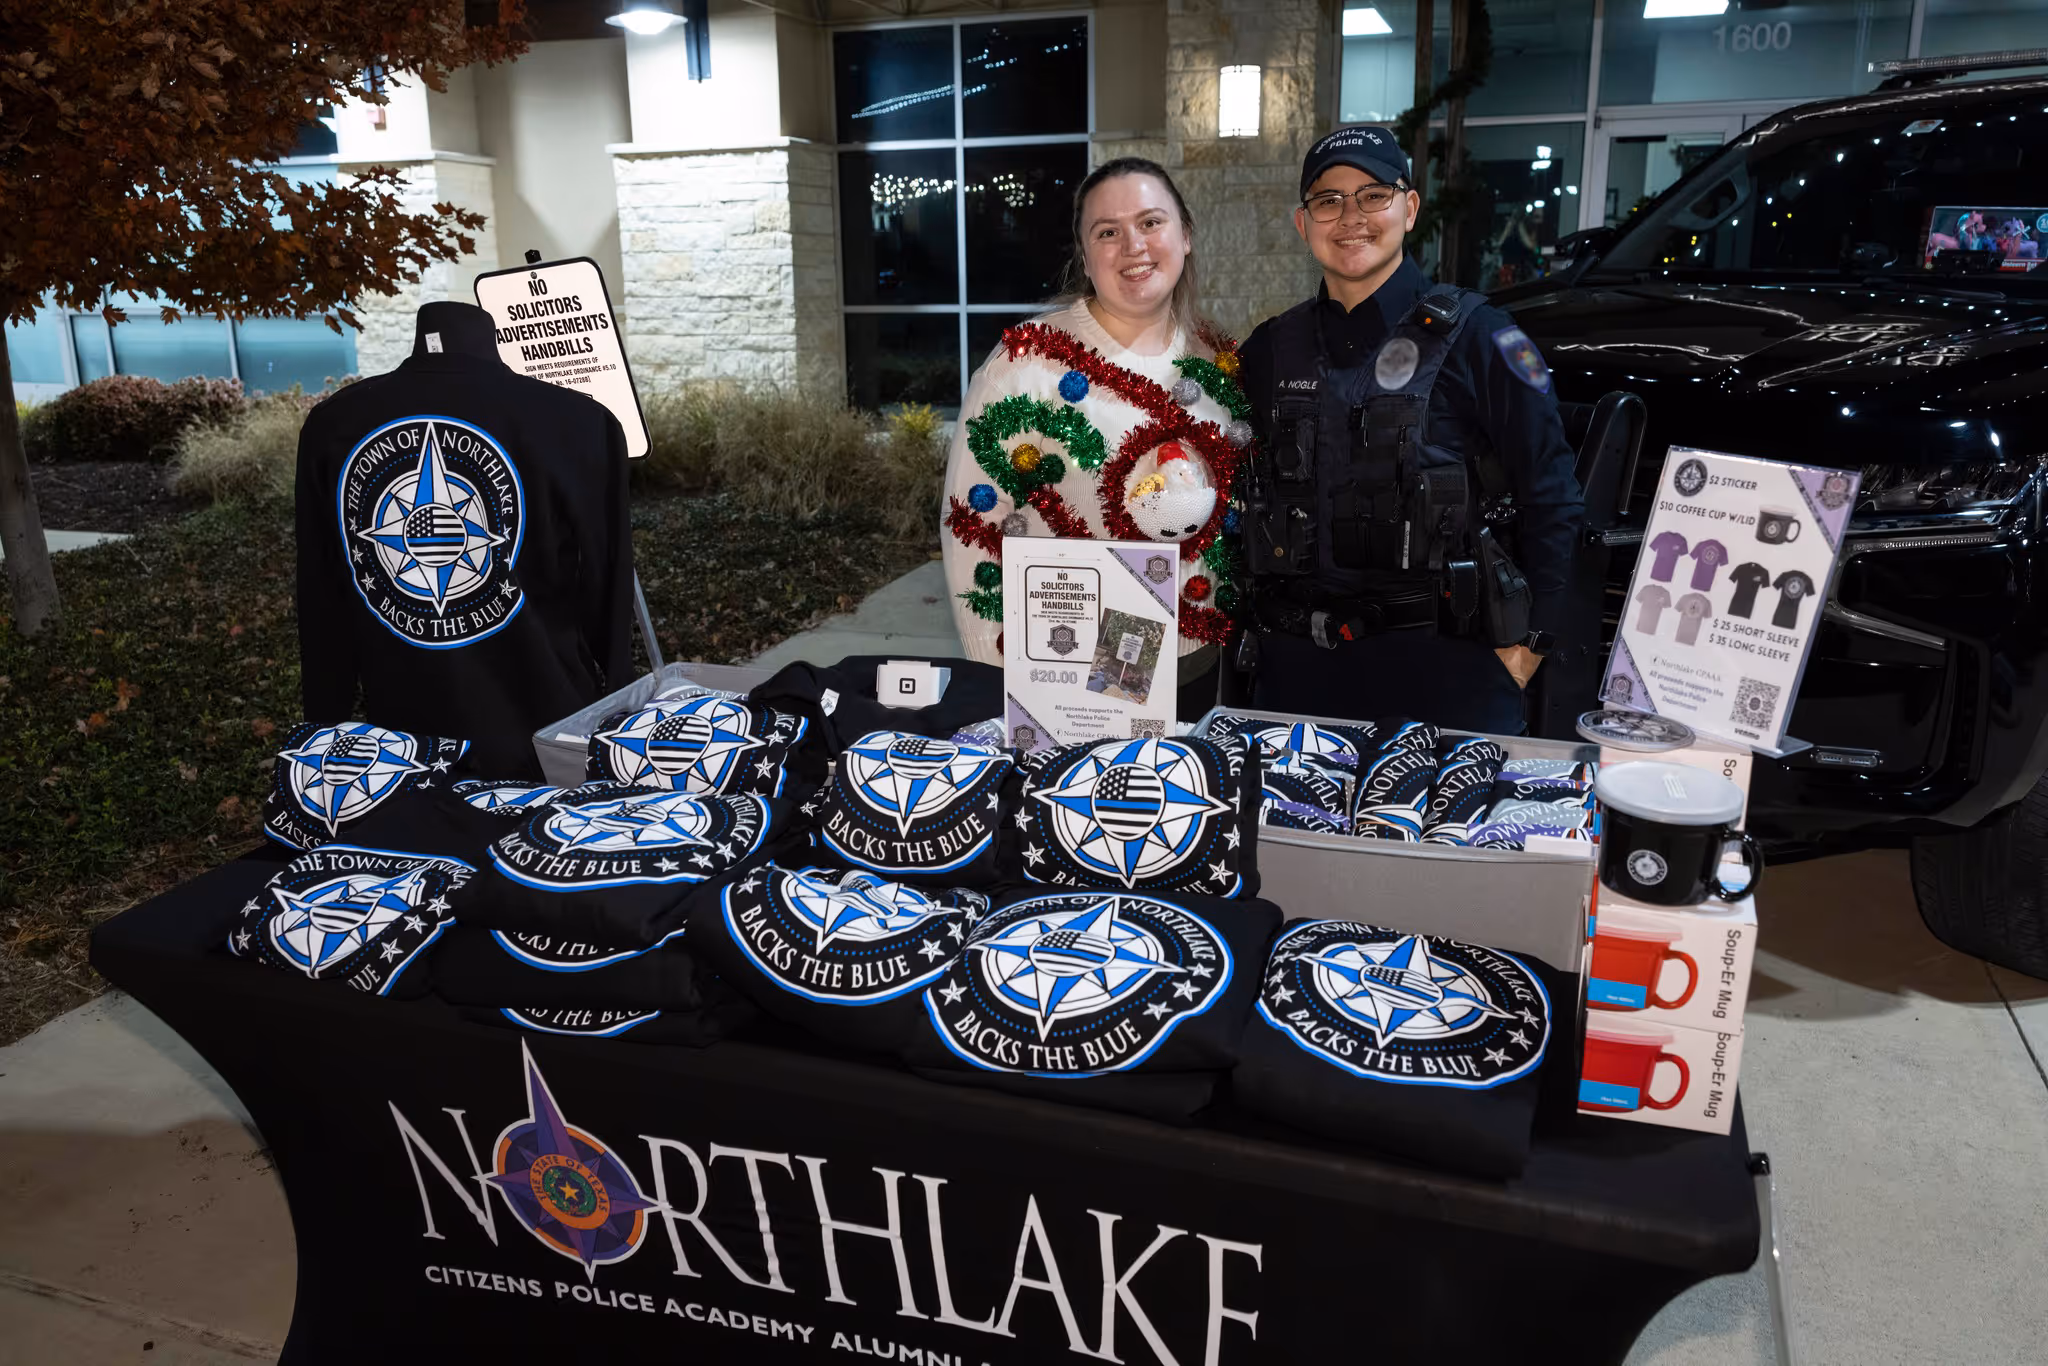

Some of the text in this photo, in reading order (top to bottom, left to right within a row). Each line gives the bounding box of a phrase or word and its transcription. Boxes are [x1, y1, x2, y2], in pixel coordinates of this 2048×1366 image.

[1712, 21, 1792, 52] 1600
[1329, 138, 1364, 150] POLICE
[528, 278, 548, 297] NO
[507, 295, 582, 321] SOLICITORS
[495, 313, 609, 345] ADVERTISEMENTS
[521, 337, 594, 362] HANDBILLS
[537, 363, 554, 371] MEETS
[554, 358, 592, 369] REQUIREMENTS
[545, 369, 573, 378] NORTHLAKE
[574, 365, 602, 375] ORDINANCE
[1288, 380, 1319, 390] NOGLE
[349, 428, 514, 516] THE TOWN OF NORTHLAKE
[1709, 475, 1759, 491] $2 STICKER
[1660, 501, 1757, 526] $10 COFFEE CUP W/LID
[1041, 581, 1085, 592] SOLICITORS
[1057, 572, 1068, 581] NO
[1029, 590, 1097, 602] ADVERTISEMENTS
[1041, 600, 1084, 611] HANDBILLS
[379, 596, 506, 637] BACKS THE BLUE
[1720, 620, 1731, 631] 25
[1733, 624, 1765, 639] SHORT
[1766, 632, 1800, 648] SLEEVE
[1716, 635, 1727, 646] 35
[1728, 639, 1756, 654] LONG
[1757, 646, 1791, 662] SLEEVE
[1029, 668, 1078, 684] $20.00
[1062, 706, 1088, 714] proceeds
[1094, 714, 1111, 722] Police
[1063, 730, 1096, 738] Northlake
[827, 809, 986, 863] BACKS THE BLUE
[288, 853, 324, 874] THE
[327, 853, 392, 870] TOWN
[499, 832, 643, 878] BACKS THE BLUE
[1070, 896, 1100, 905] OF
[1123, 900, 1216, 961] NORTHLAKE
[1280, 935, 1318, 952] THE
[1310, 922, 1374, 940] TOWN
[740, 904, 911, 989] BACKS THE BLUE
[1720, 929, 1742, 986] Soup-Er
[1712, 989, 1733, 1019] Mug
[954, 1010, 1142, 1070] BACKS THE BLUE
[1287, 1009, 1482, 1078] BACKS THE BLUE
[1711, 1032, 1732, 1087] Soup-Er
[1703, 1089, 1724, 1119] Mug
[532, 1155, 608, 1213] THE STATE OF TEXAS
[425, 1265, 963, 1366] CITIZENS POLICE ACADEMY ALUMNI
